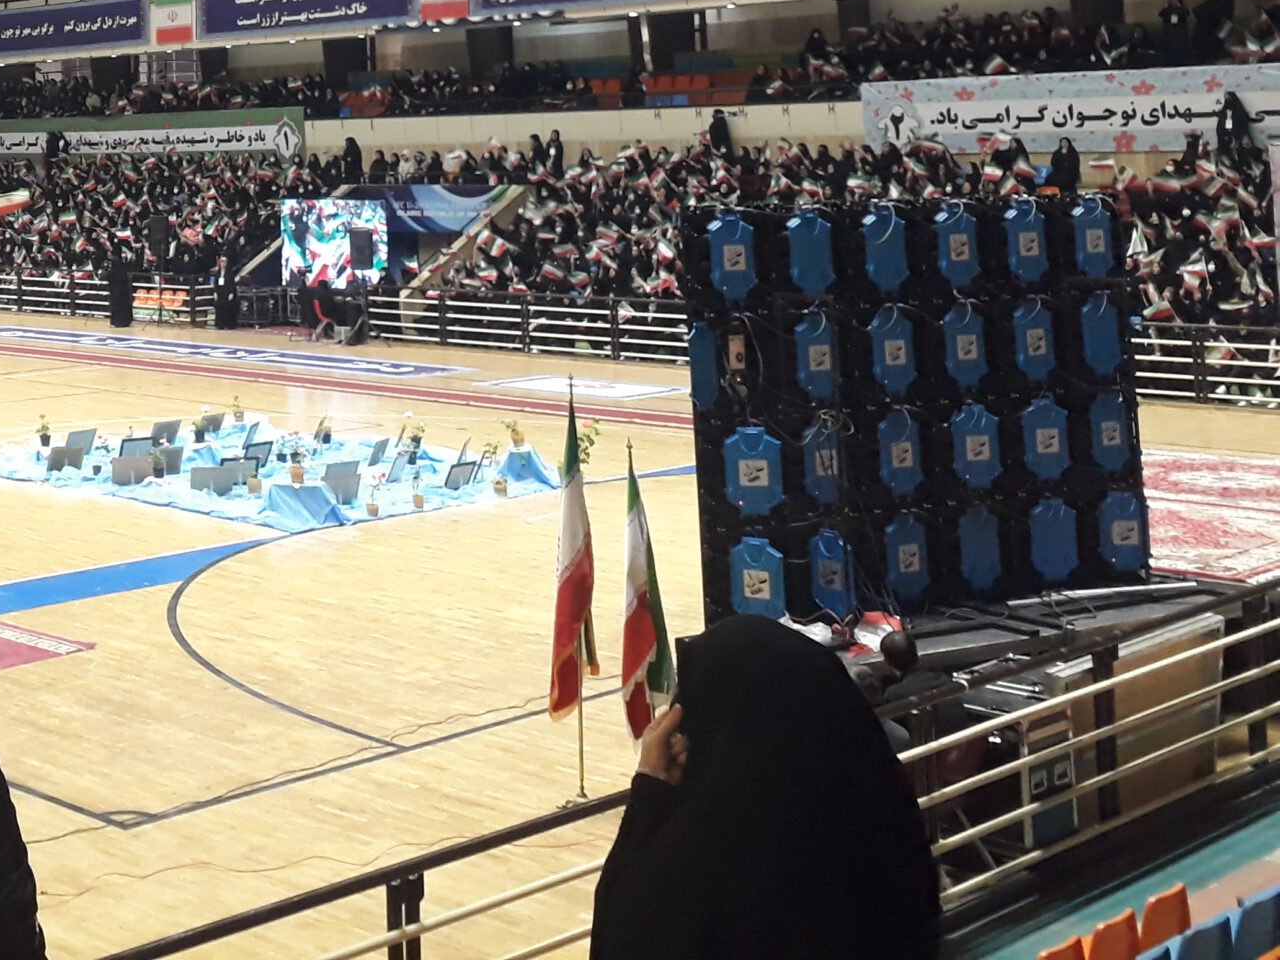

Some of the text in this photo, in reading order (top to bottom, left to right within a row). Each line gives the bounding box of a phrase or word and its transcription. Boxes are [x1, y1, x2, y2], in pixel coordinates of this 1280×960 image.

[346, 1, 368, 15] خاک
[236, 13, 260, 26] است
[962, 103, 1049, 130] گرامی
[1052, 101, 1138, 129] نوجوان
[209, 129, 245, 148] خاطره
